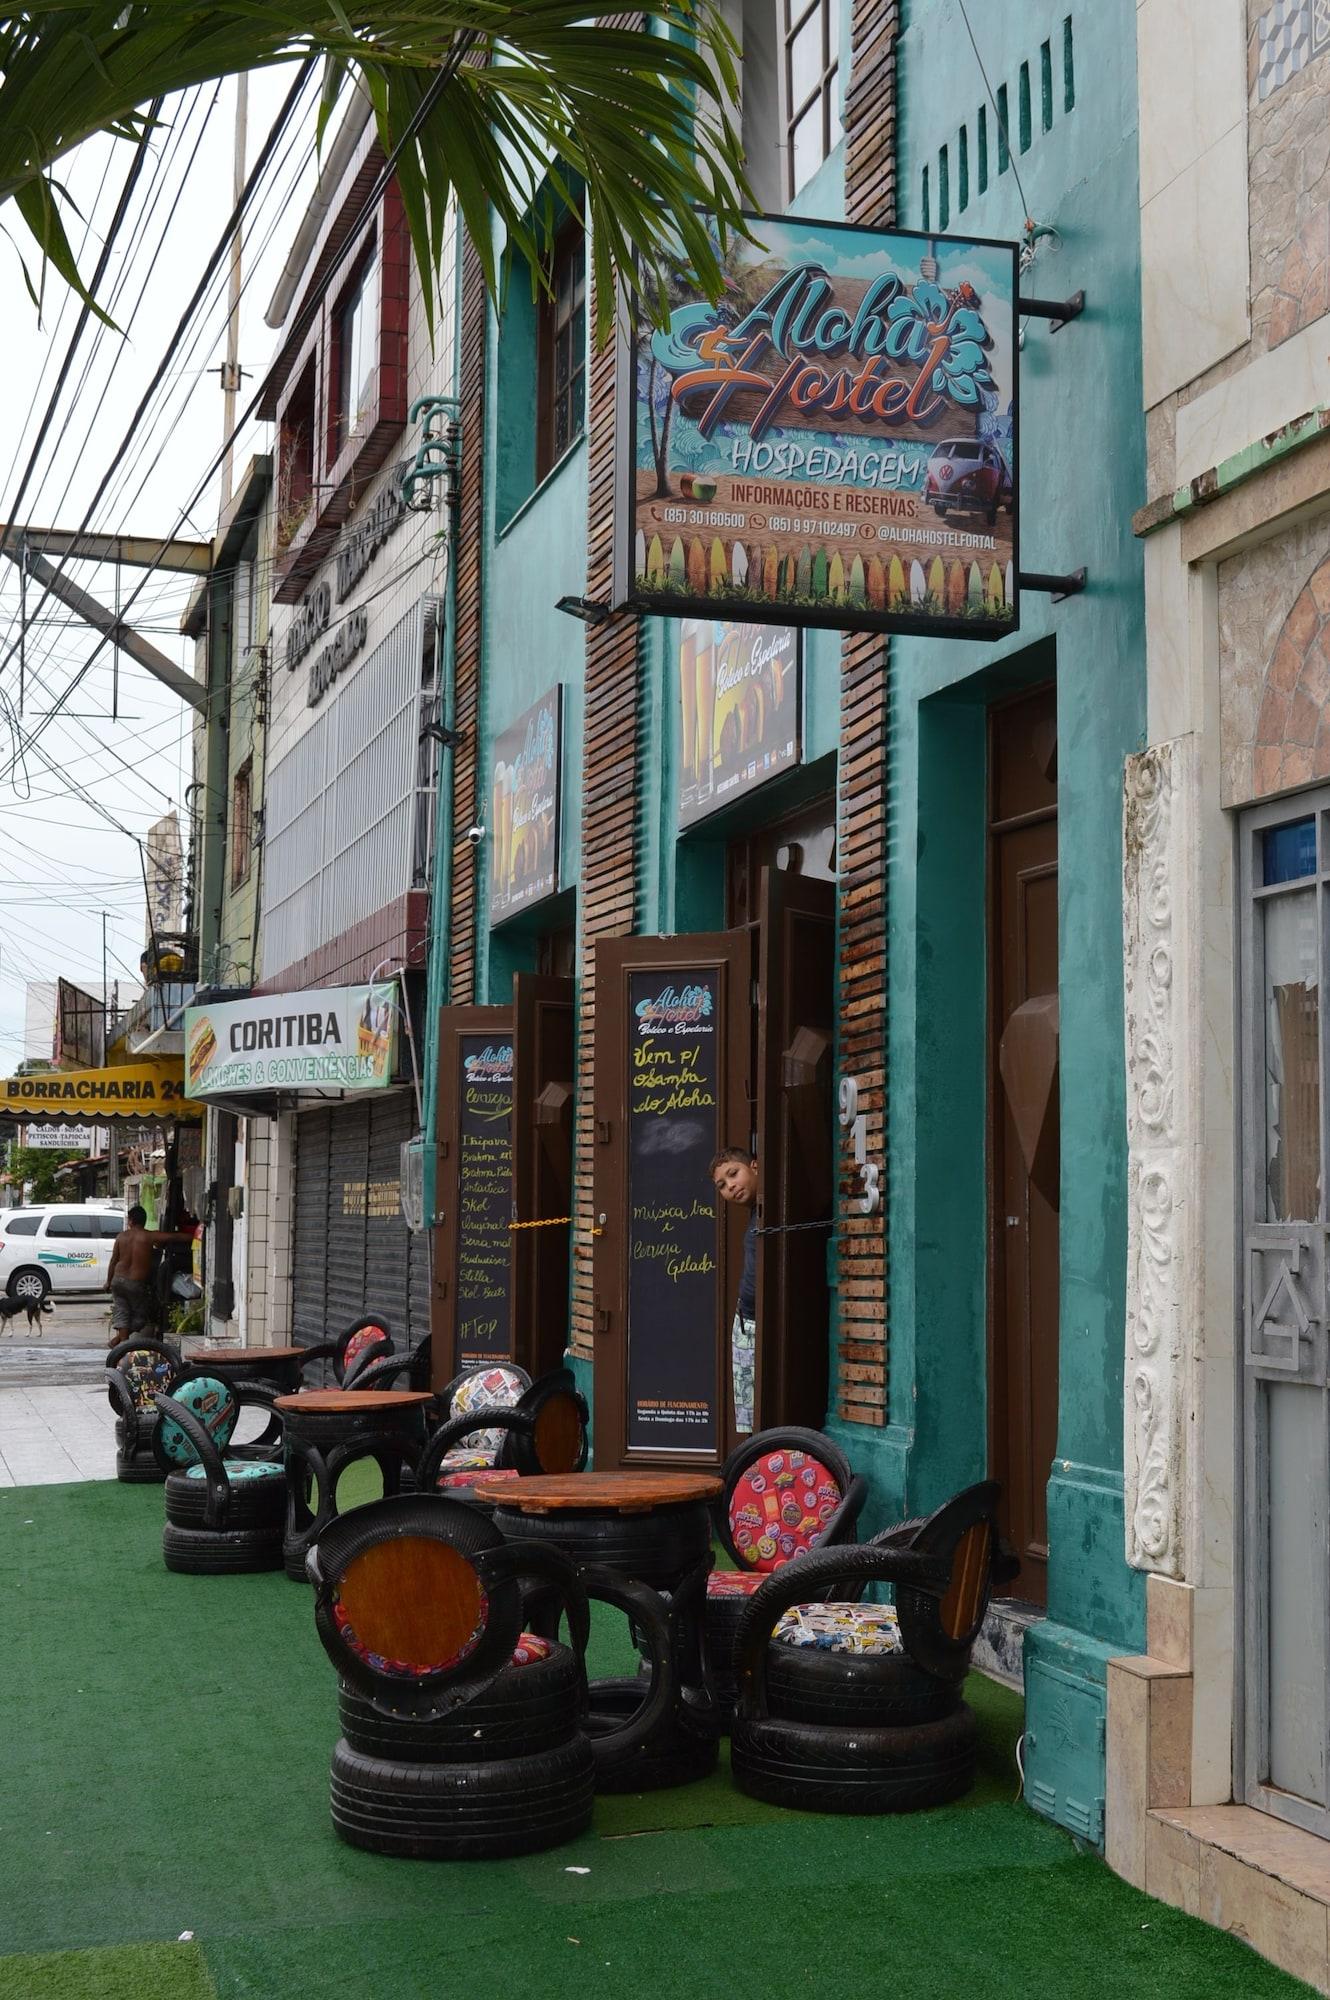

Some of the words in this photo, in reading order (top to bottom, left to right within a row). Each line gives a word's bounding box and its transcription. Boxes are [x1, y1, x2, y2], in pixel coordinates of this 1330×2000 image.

[723, 261, 927, 362] Aloha
[697, 333, 950, 442] Hostel
[732, 439, 921, 488] HOSPEDAGEM
[731, 484, 830, 511] INFORMAÇÕES
[834, 493, 842, 511] E
[846, 494, 920, 518] RESERVAS:
[664, 508, 687, 524] (85)
[689, 509, 745, 528] 30160500
[768, 516, 791, 531] (85)
[793, 517, 801, 533] 9
[802, 518, 858, 538] 97102497
[878, 525, 998, 550] @ALOHAHOSTELFORTAL
[652, 985, 698, 1009] Aloha
[230, 1011, 342, 1053] CORITIBA
[255, 1061, 265, 1084] &
[267, 1052, 374, 1083] CONVENIÊNCIAS
[633, 1038, 676, 1067] Vem
[7, 1081, 156, 1099] BORRACHARIA
[660, 1088, 716, 1114] Aloha
